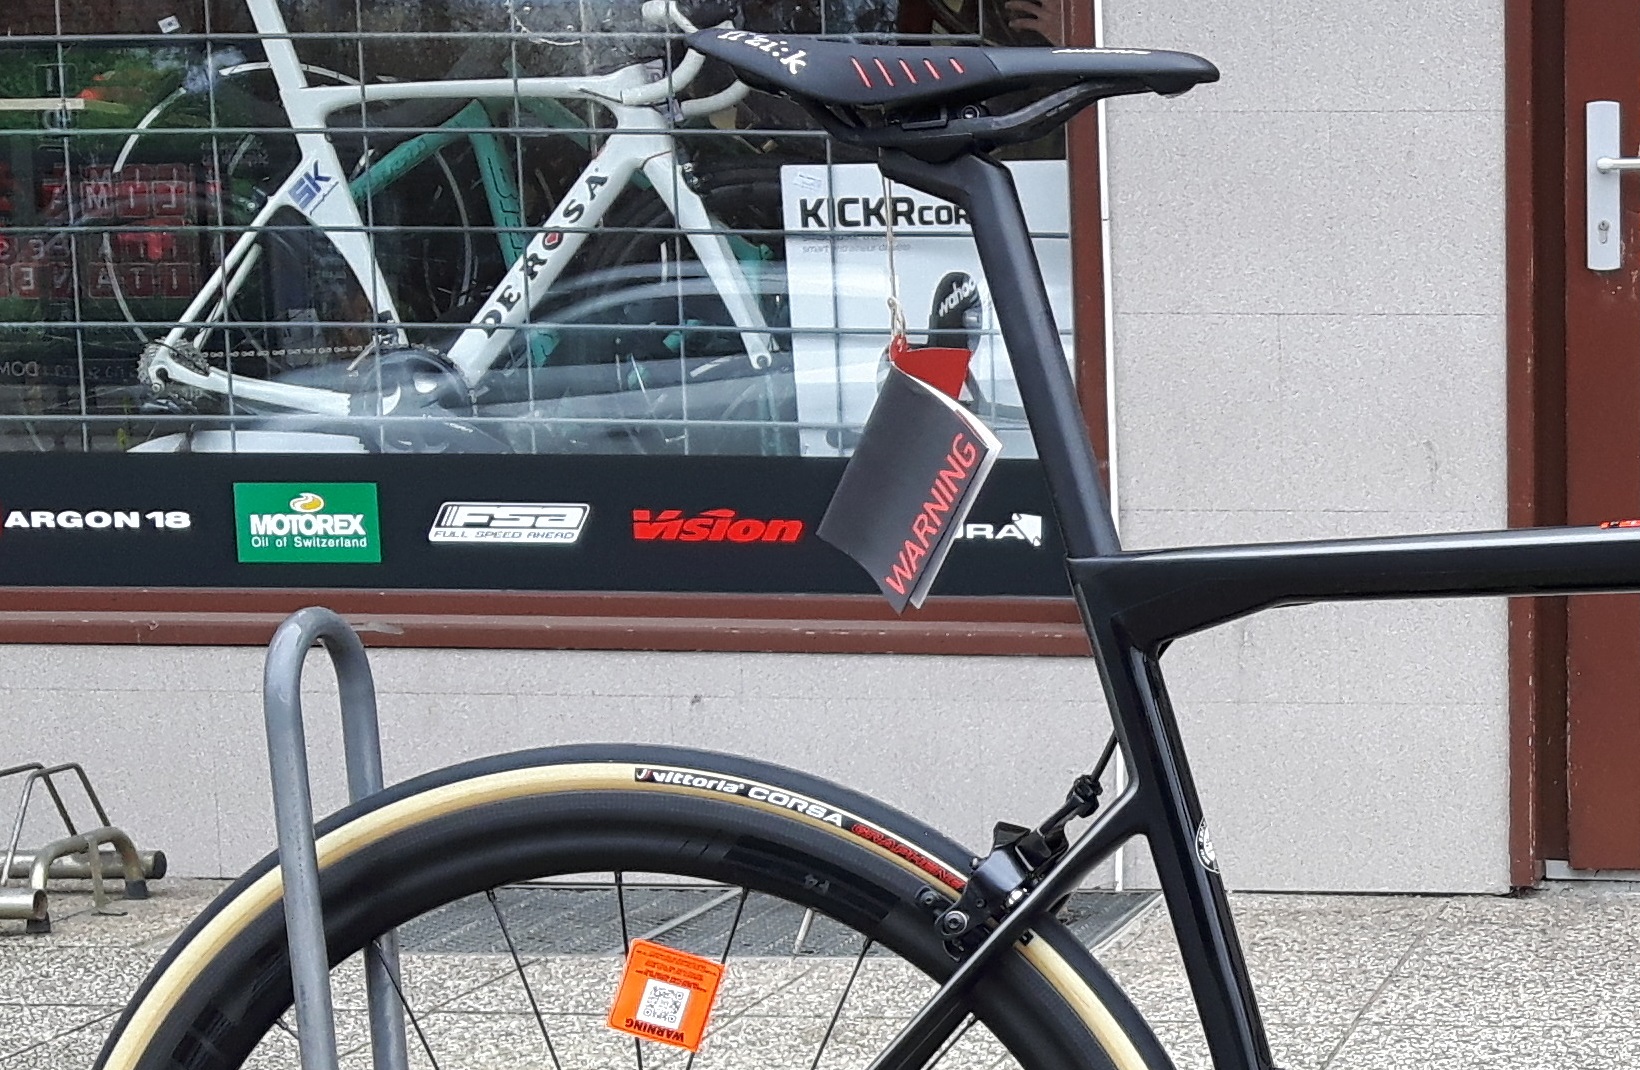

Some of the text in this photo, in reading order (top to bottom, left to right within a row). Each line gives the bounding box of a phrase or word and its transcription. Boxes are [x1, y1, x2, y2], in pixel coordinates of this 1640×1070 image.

[800, 197, 972, 228] KICKR COR
[481, 284, 521, 338] DE
[520, 169, 609, 280] ROSA
[938, 278, 978, 318] wahoo
[3, 510, 192, 529] ARGON 18
[250, 513, 366, 537] MOTOREX
[631, 508, 804, 543] Vision
[884, 432, 979, 597] WARNING
[251, 536, 368, 549] Oil of Switzerland
[433, 530, 576, 541] FULL SPEED AHEAD
[747, 786, 843, 827] CORSA
[624, 1017, 686, 1043] WARNING
